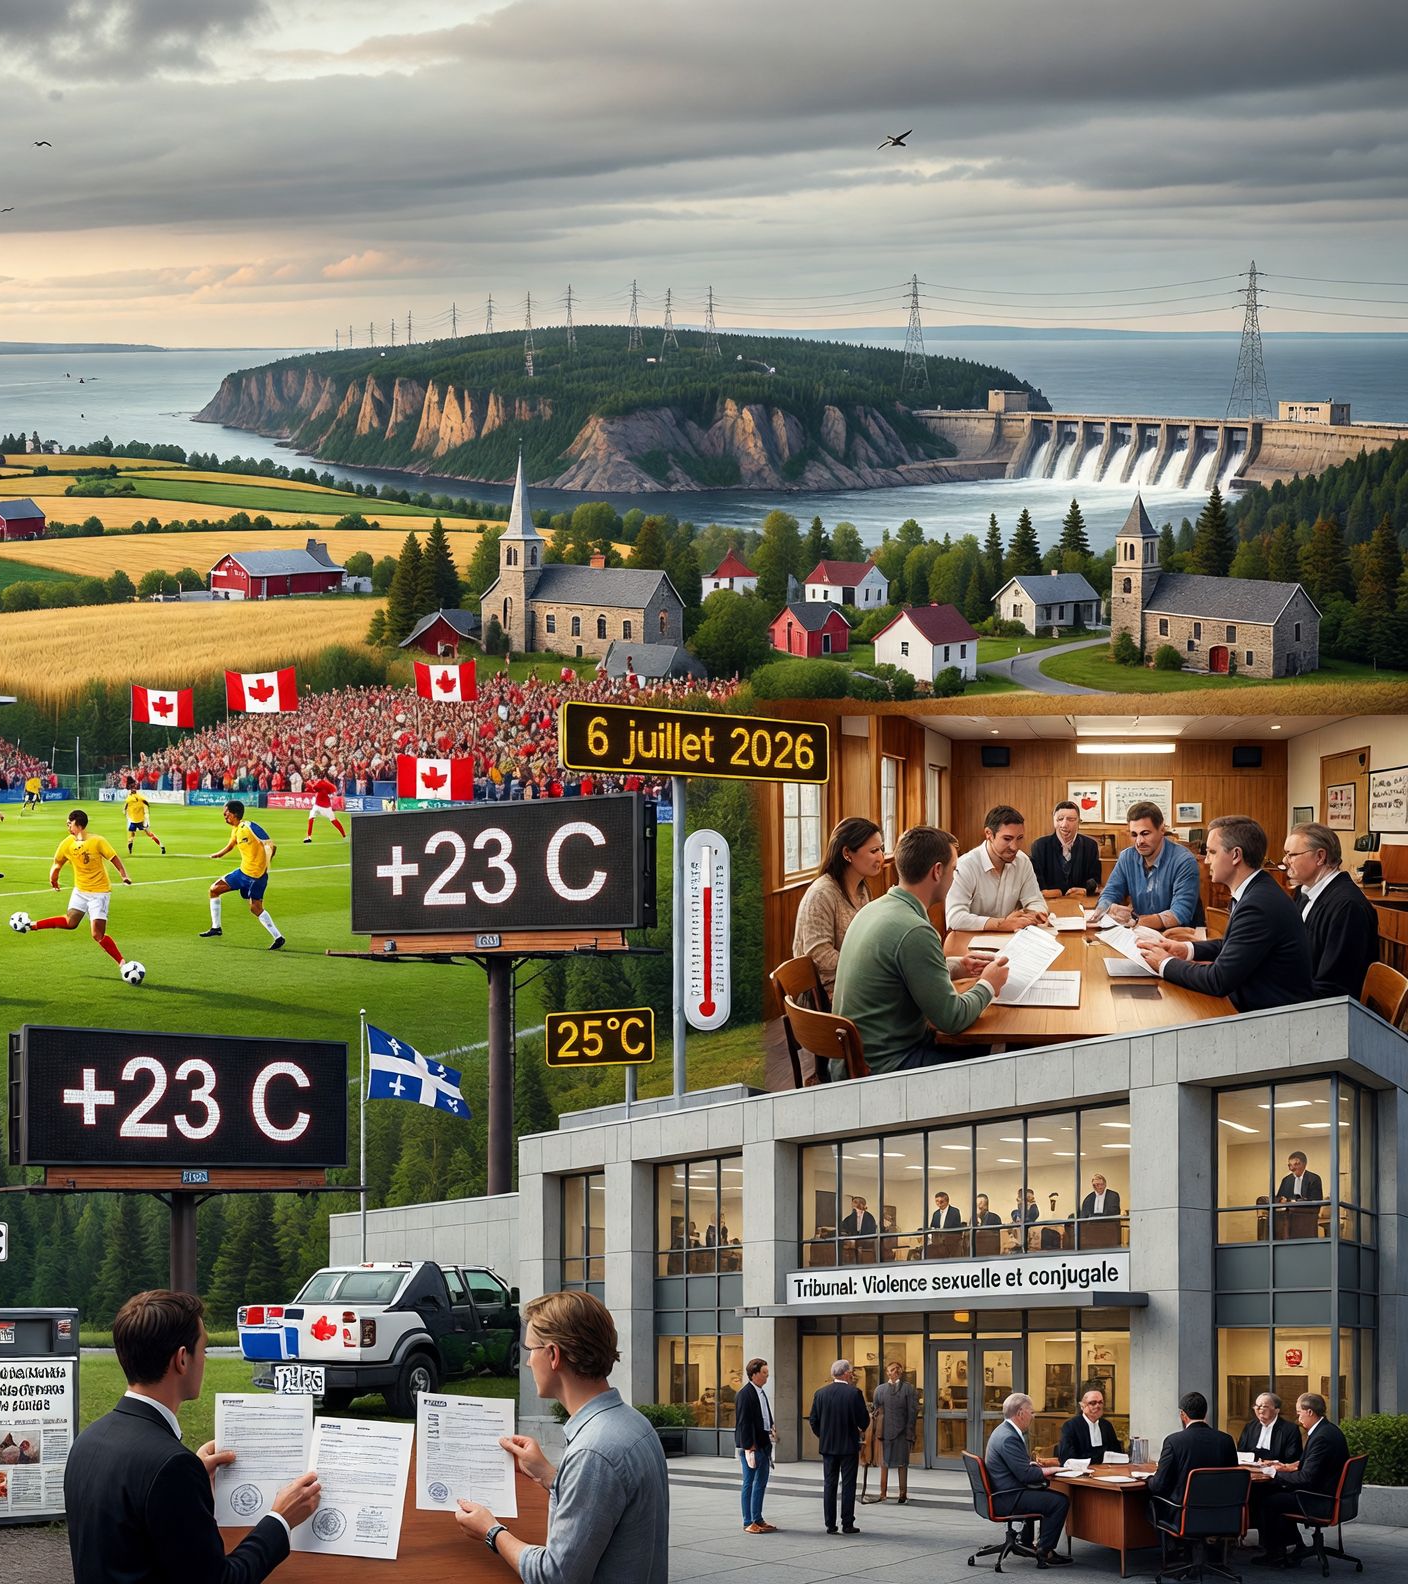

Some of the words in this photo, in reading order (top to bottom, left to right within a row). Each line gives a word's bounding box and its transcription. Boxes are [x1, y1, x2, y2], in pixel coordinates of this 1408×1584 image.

[587, 715, 610, 757] 6
[621, 719, 716, 766] juillet
[728, 726, 816, 771] 2026
[375, 826, 518, 907] +23
[545, 820, 609, 902] C
[556, 1016, 645, 1058] 25°C
[62, 1055, 222, 1141] +23
[250, 1060, 312, 1143] C
[793, 1275, 859, 1298] Tribunal:
[862, 1273, 928, 1295] Violence
[931, 1267, 1002, 1291] sexuelle
[1005, 1267, 1024, 1288] et
[1028, 1260, 1120, 1290] conjugale
